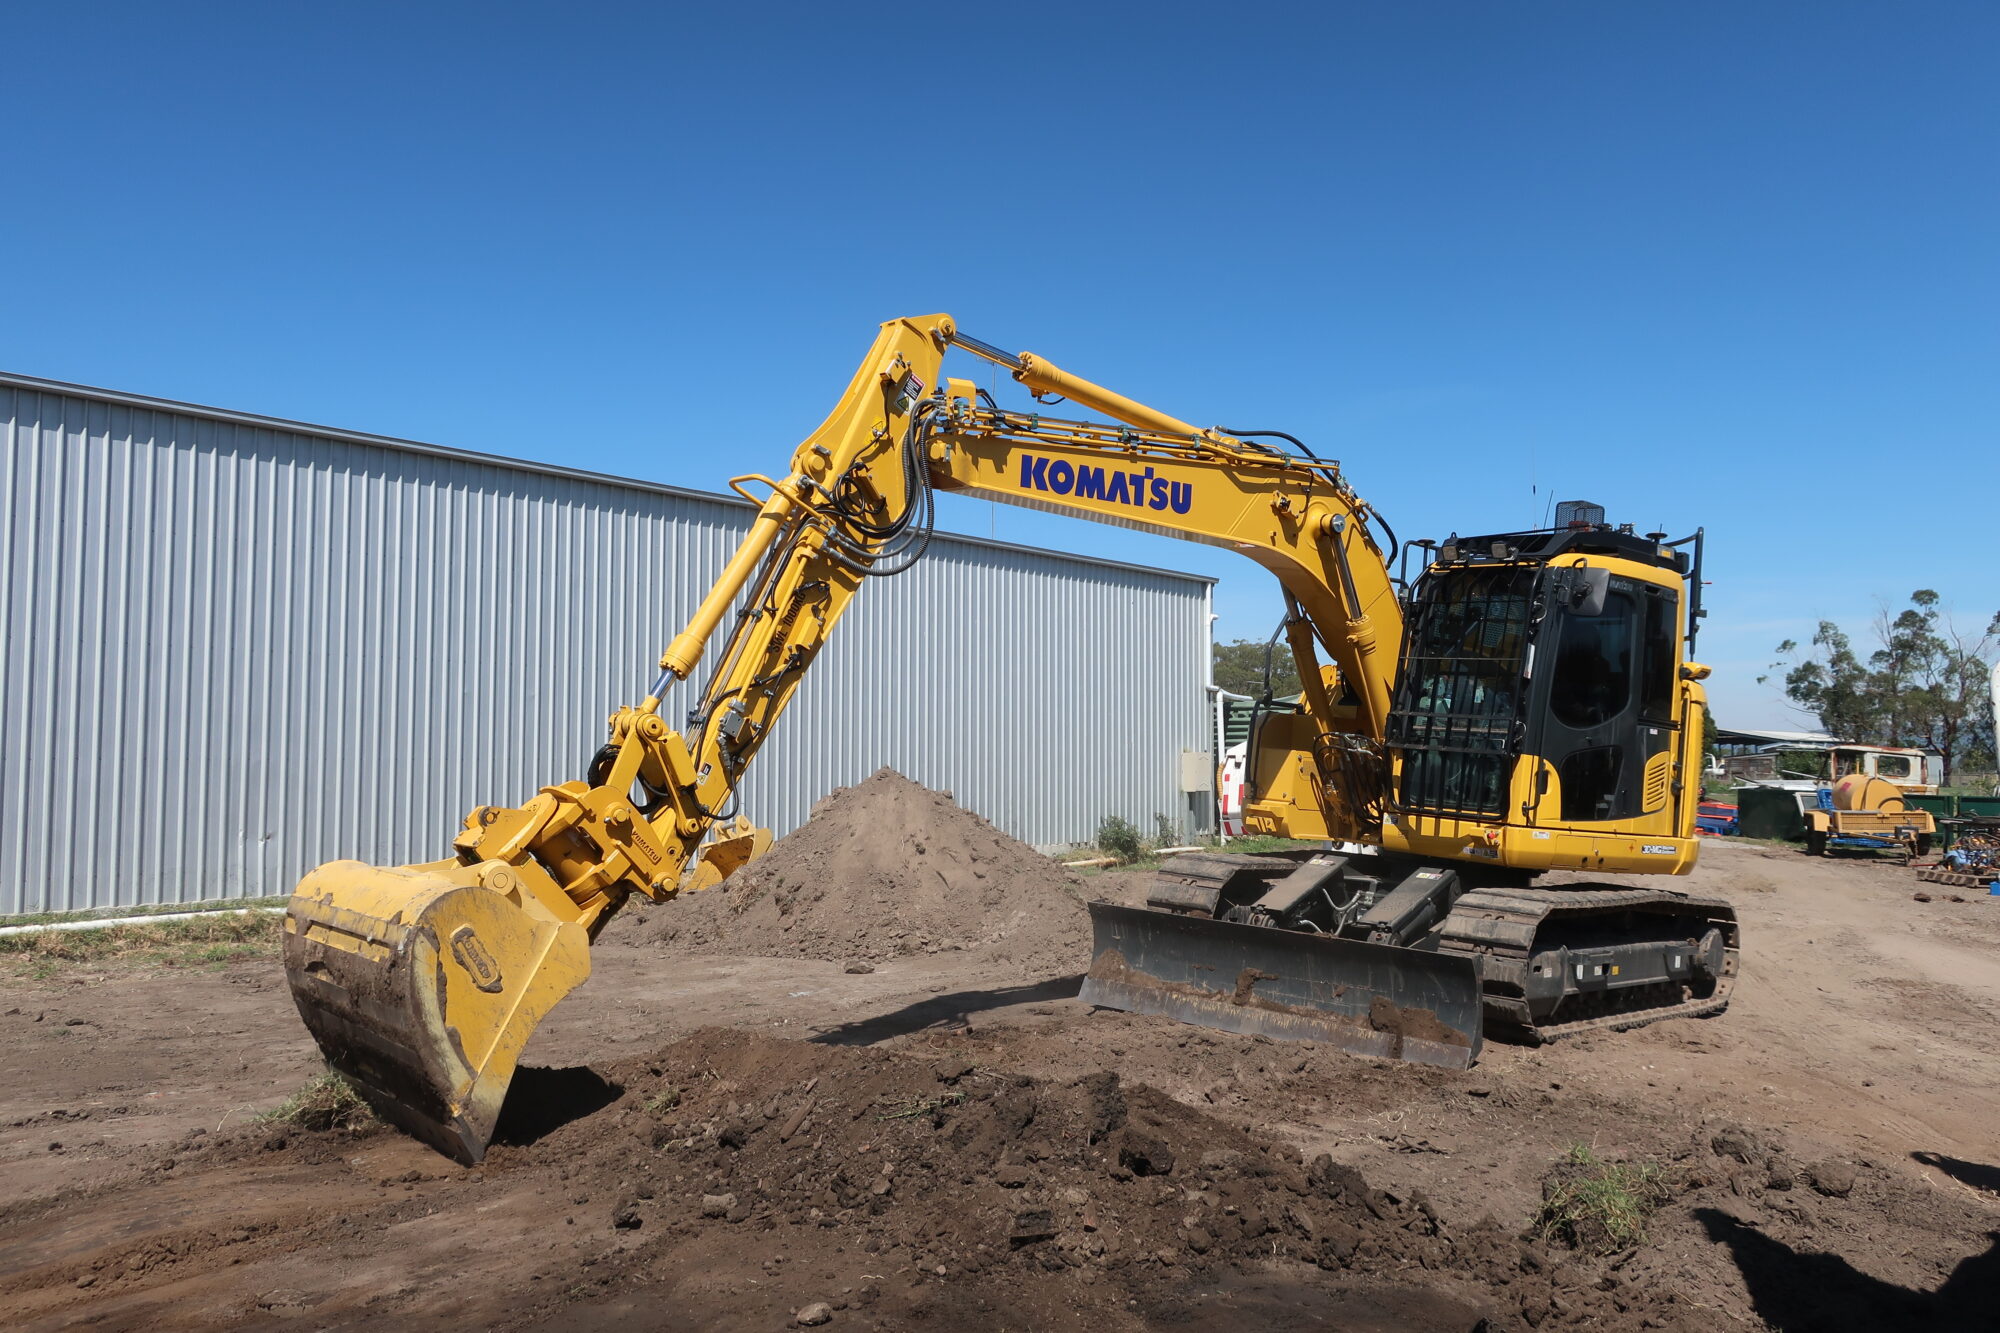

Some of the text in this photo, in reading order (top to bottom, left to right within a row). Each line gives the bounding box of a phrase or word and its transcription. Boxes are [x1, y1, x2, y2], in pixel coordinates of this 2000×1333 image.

[1020, 454, 1193, 515] KOMATSU
[772, 592, 806, 653] SWL 1000KG
[631, 830, 659, 861] KOMATSU
